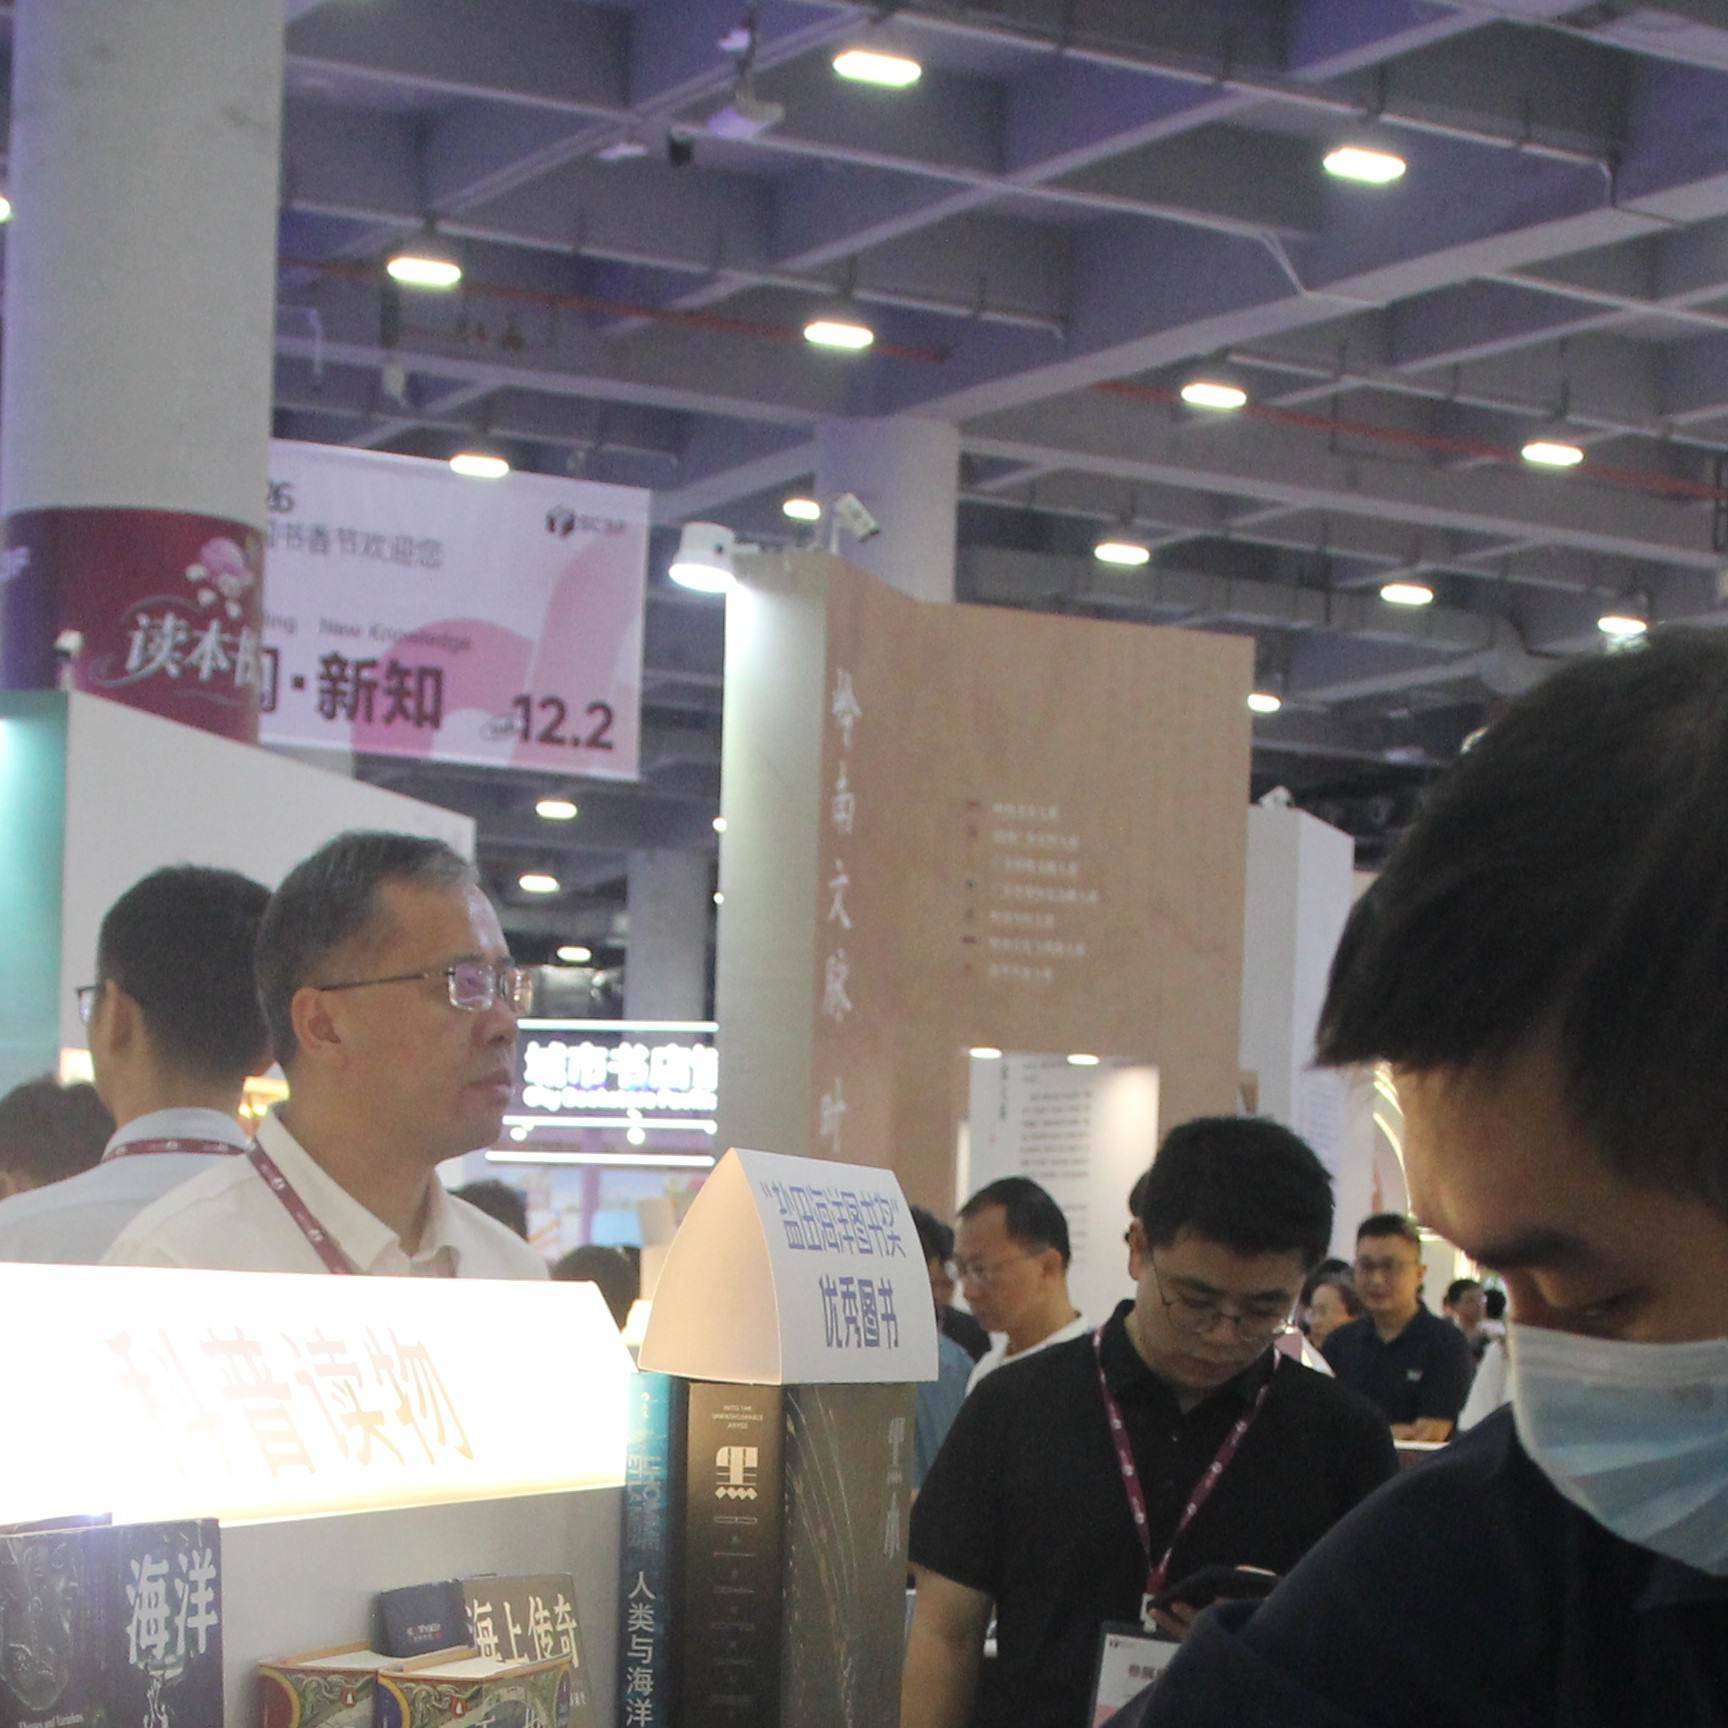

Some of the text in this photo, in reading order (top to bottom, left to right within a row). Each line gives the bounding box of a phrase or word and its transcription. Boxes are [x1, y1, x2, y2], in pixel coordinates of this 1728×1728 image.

[512, 692, 616, 750] 12.2
[818, 1273, 901, 1351] 优秀图书
[126, 1548, 219, 1665] 海洋
[465, 1593, 580, 1669] 海上传奇
